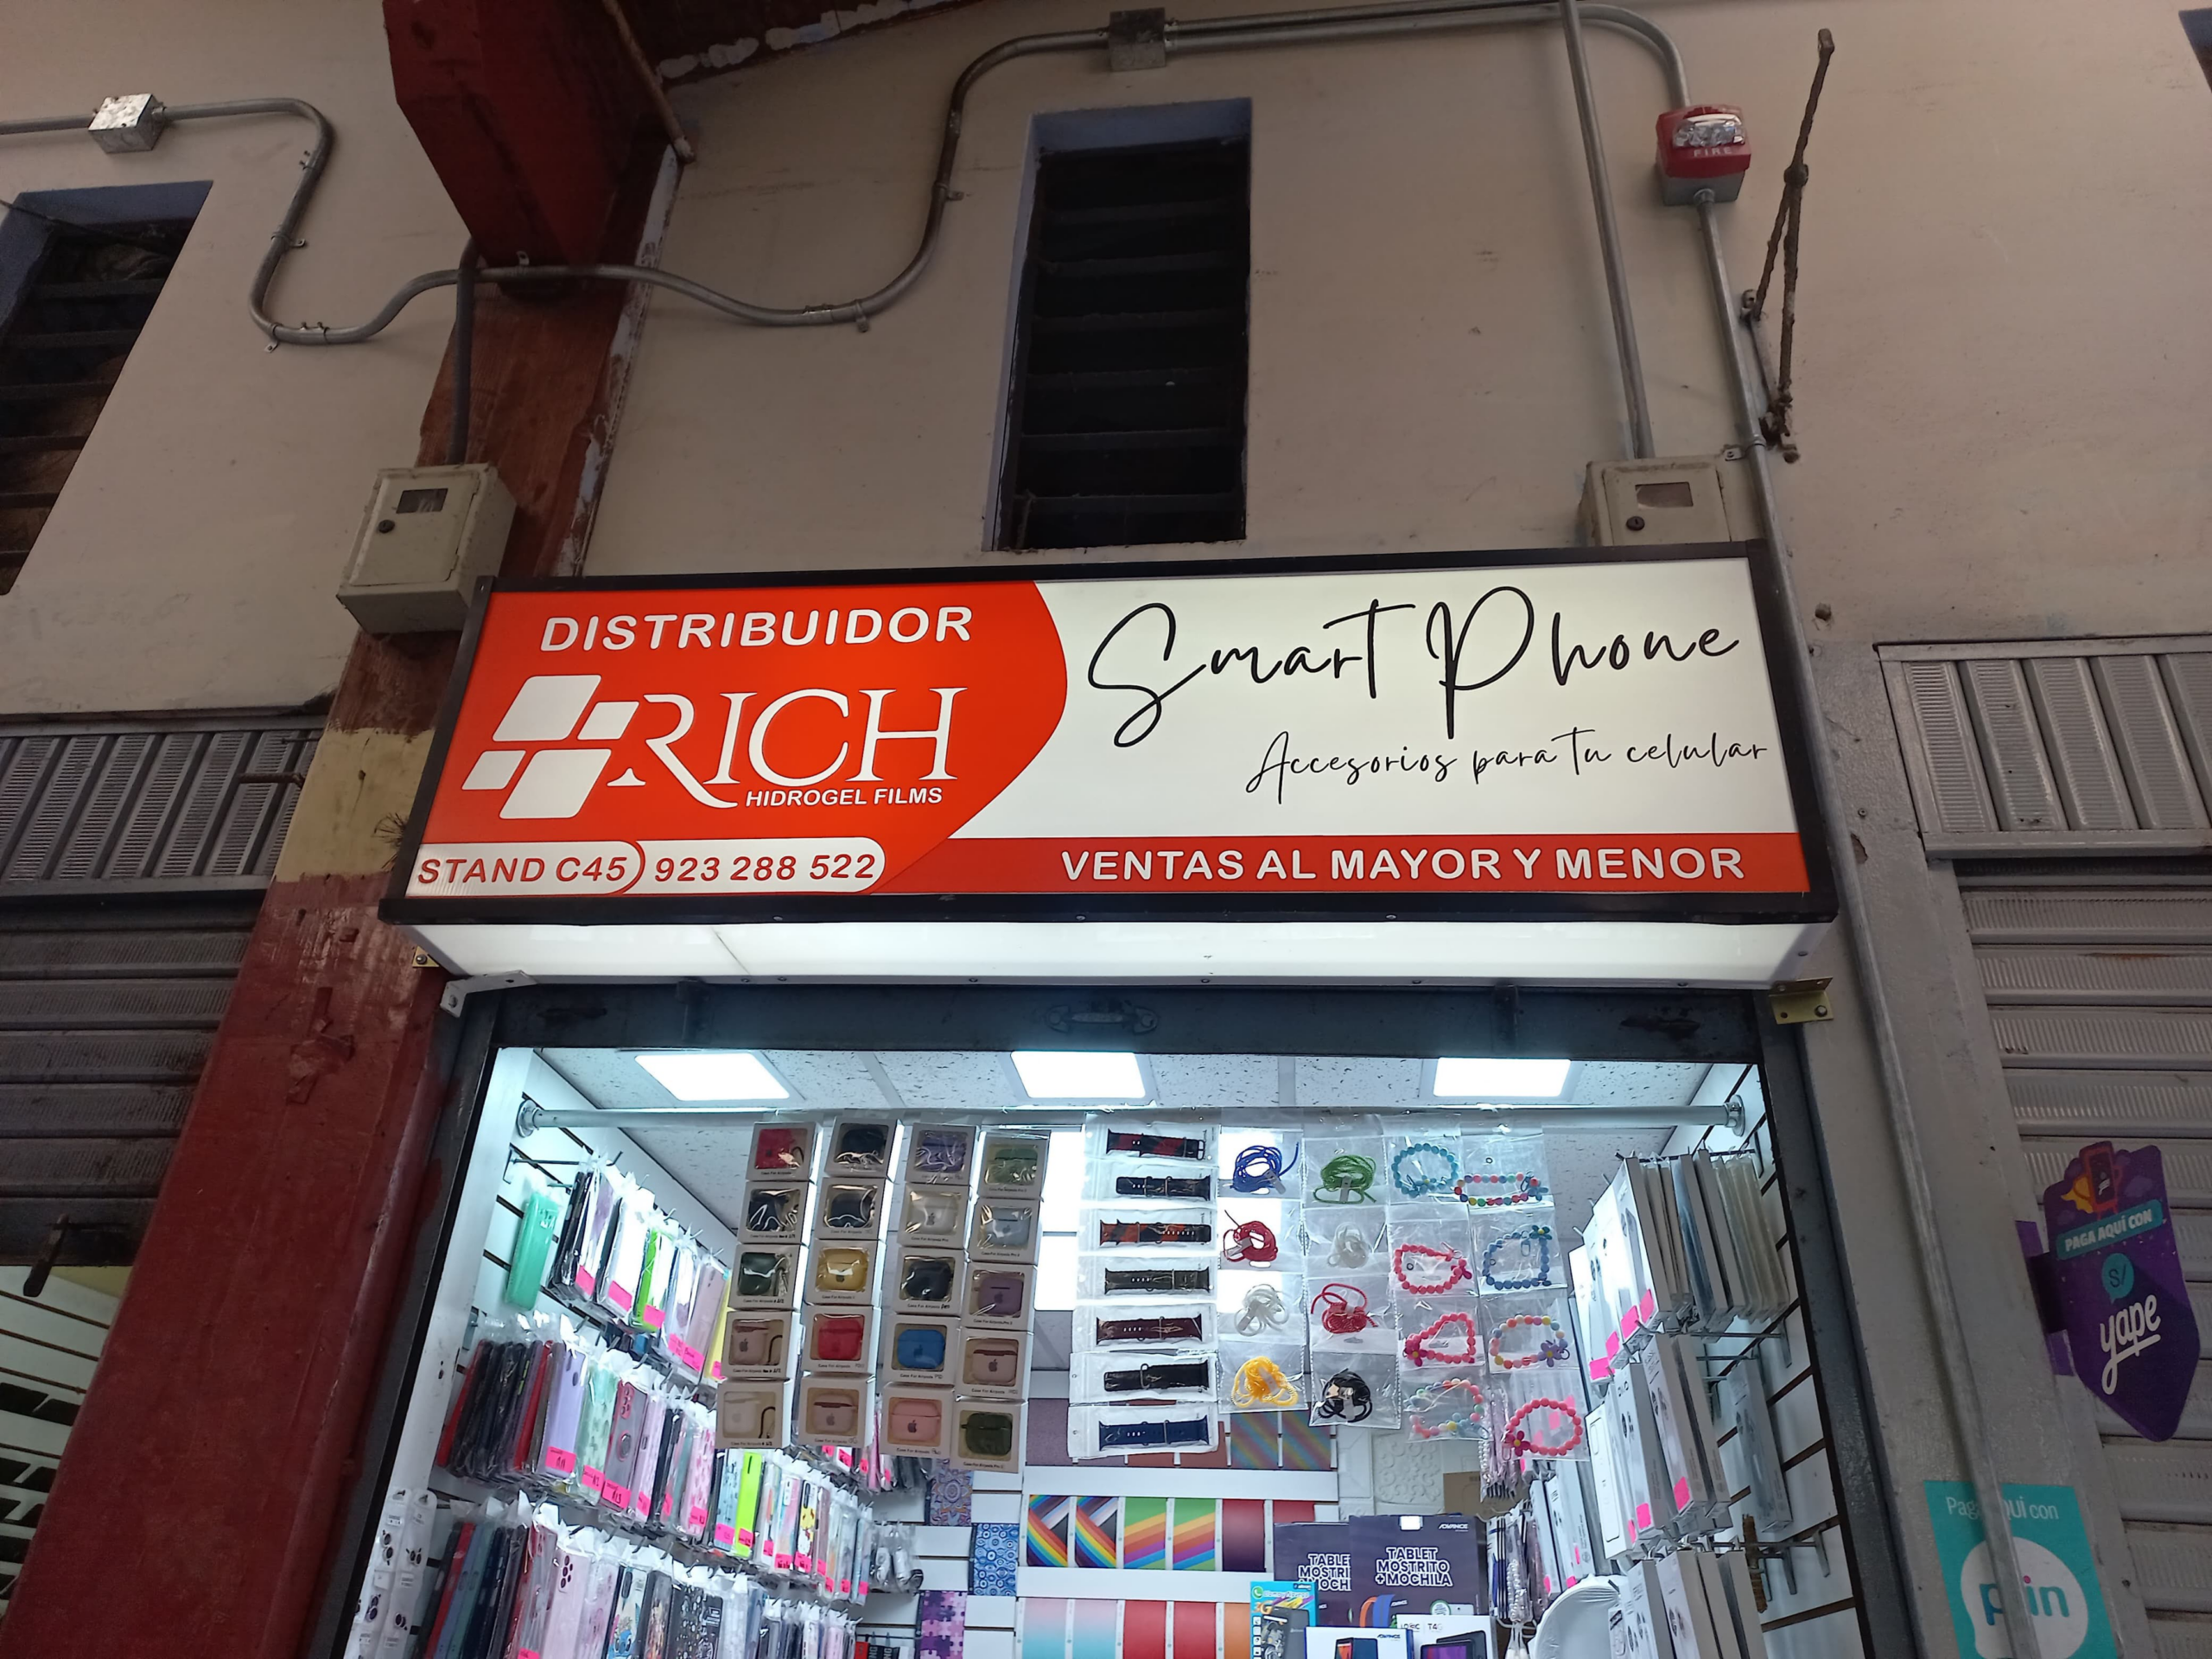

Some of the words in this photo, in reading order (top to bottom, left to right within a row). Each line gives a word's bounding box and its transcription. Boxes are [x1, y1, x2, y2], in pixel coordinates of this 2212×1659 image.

[1694, 147, 1732, 157] FIRE
[540, 607, 973, 652] DISTRIBUIDOR
[1087, 598, 1415, 747] Smart
[1425, 585, 1739, 740] Phone
[607, 687, 969, 809] RICH
[1245, 729, 1458, 804] Accesorios
[1472, 748, 1555, 784] para
[1626, 729, 1768, 764] celular
[745, 788, 868, 808] HIDROGEL
[874, 785, 944, 805] FILMS
[417, 857, 545, 885] STAND
[555, 855, 627, 883] C45
[654, 856, 721, 883] 923
[730, 855, 797, 881] 288
[809, 854, 876, 880] 522
[1061, 849, 1244, 880] VENTAS
[1247, 849, 1315, 880] AL
[1331, 849, 1500, 880] MAYOR
[1512, 848, 1542, 880] Y
[1556, 847, 1745, 880] MENOR
[2064, 1230, 2096, 1252] PAGA
[2098, 1215, 2126, 1241] AQUÍ
[2128, 1209, 2152, 1230] CON
[2100, 1294, 2161, 1395] yape
[1946, 1497, 1979, 1520] Pag
[2029, 1503, 2059, 1519] con
[1307, 1553, 1351, 1566] TABLE
[1376, 1559, 1452, 1574] MOSTRITO
[1385, 1547, 1440, 1560] TABLET
[1298, 1565, 1351, 1579] MOSTRI
[1979, 1575, 2069, 1626] pin
